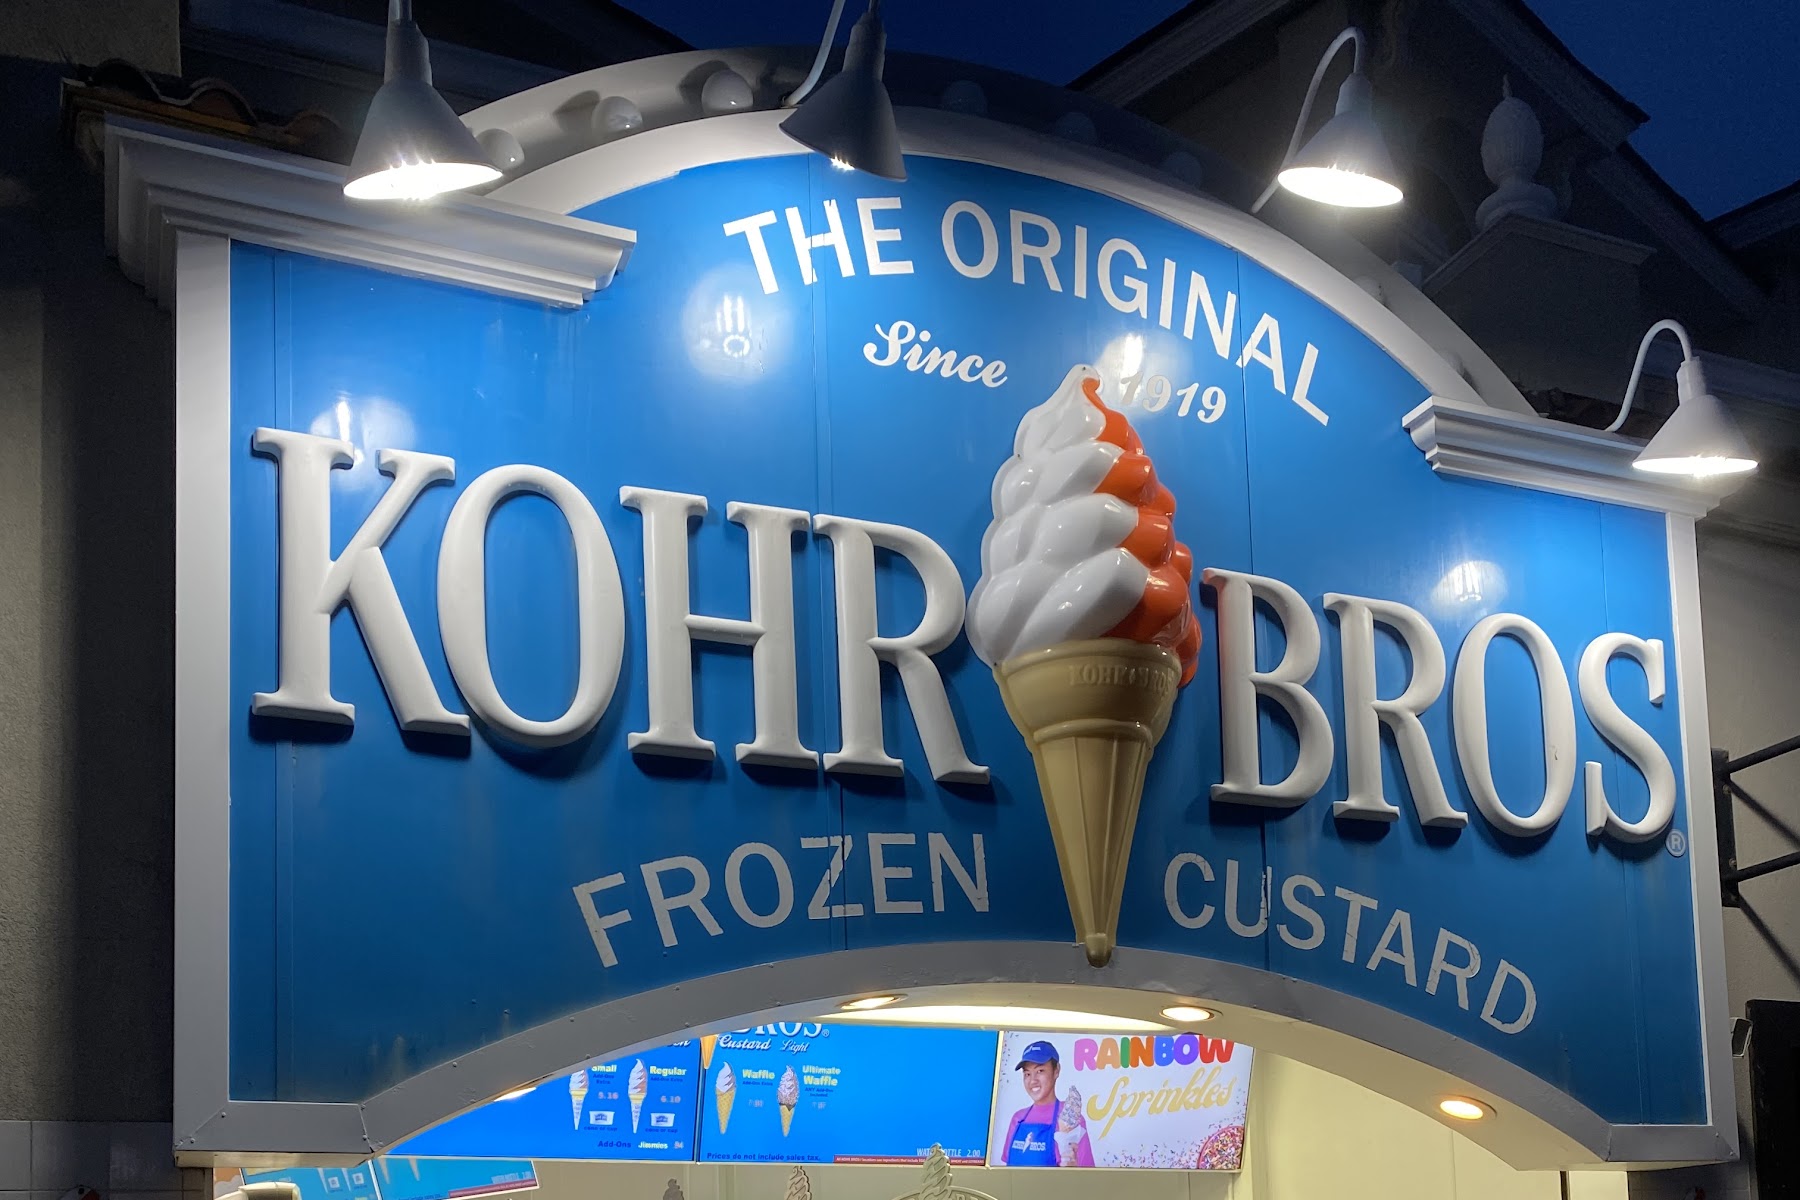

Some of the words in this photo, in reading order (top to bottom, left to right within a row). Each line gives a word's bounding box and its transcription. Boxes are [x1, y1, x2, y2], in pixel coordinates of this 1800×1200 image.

[723, 197, 914, 295] THE
[941, 200, 1329, 427] ORIGINAL
[863, 320, 1008, 388] Since
[1121, 371, 1226, 423] 1919
[252, 427, 990, 785] KOHR
[1202, 567, 1676, 843] BROS
[572, 832, 989, 968] FROZEN
[1164, 852, 1537, 1034] CUSTARD
[718, 1034, 771, 1050] Custard
[781, 1039, 810, 1054] Light
[1073, 1033, 1235, 1071] RAINBOW
[591, 1064, 618, 1073] Small
[649, 1066, 688, 1077] Regular
[742, 1069, 776, 1080] Waffle
[802, 1064, 841, 1075] Ultimate
[803, 1075, 839, 1087] Waffle
[1086, 1065, 1237, 1141] Sprinkles
[597, 1140, 632, 1149] Add-Ons
[638, 1140, 669, 1150] Jimmies
[707, 1152, 731, 1160] Prices
[732, 1152, 742, 1160] do
[942, 1149, 962, 1157] OTTLE
